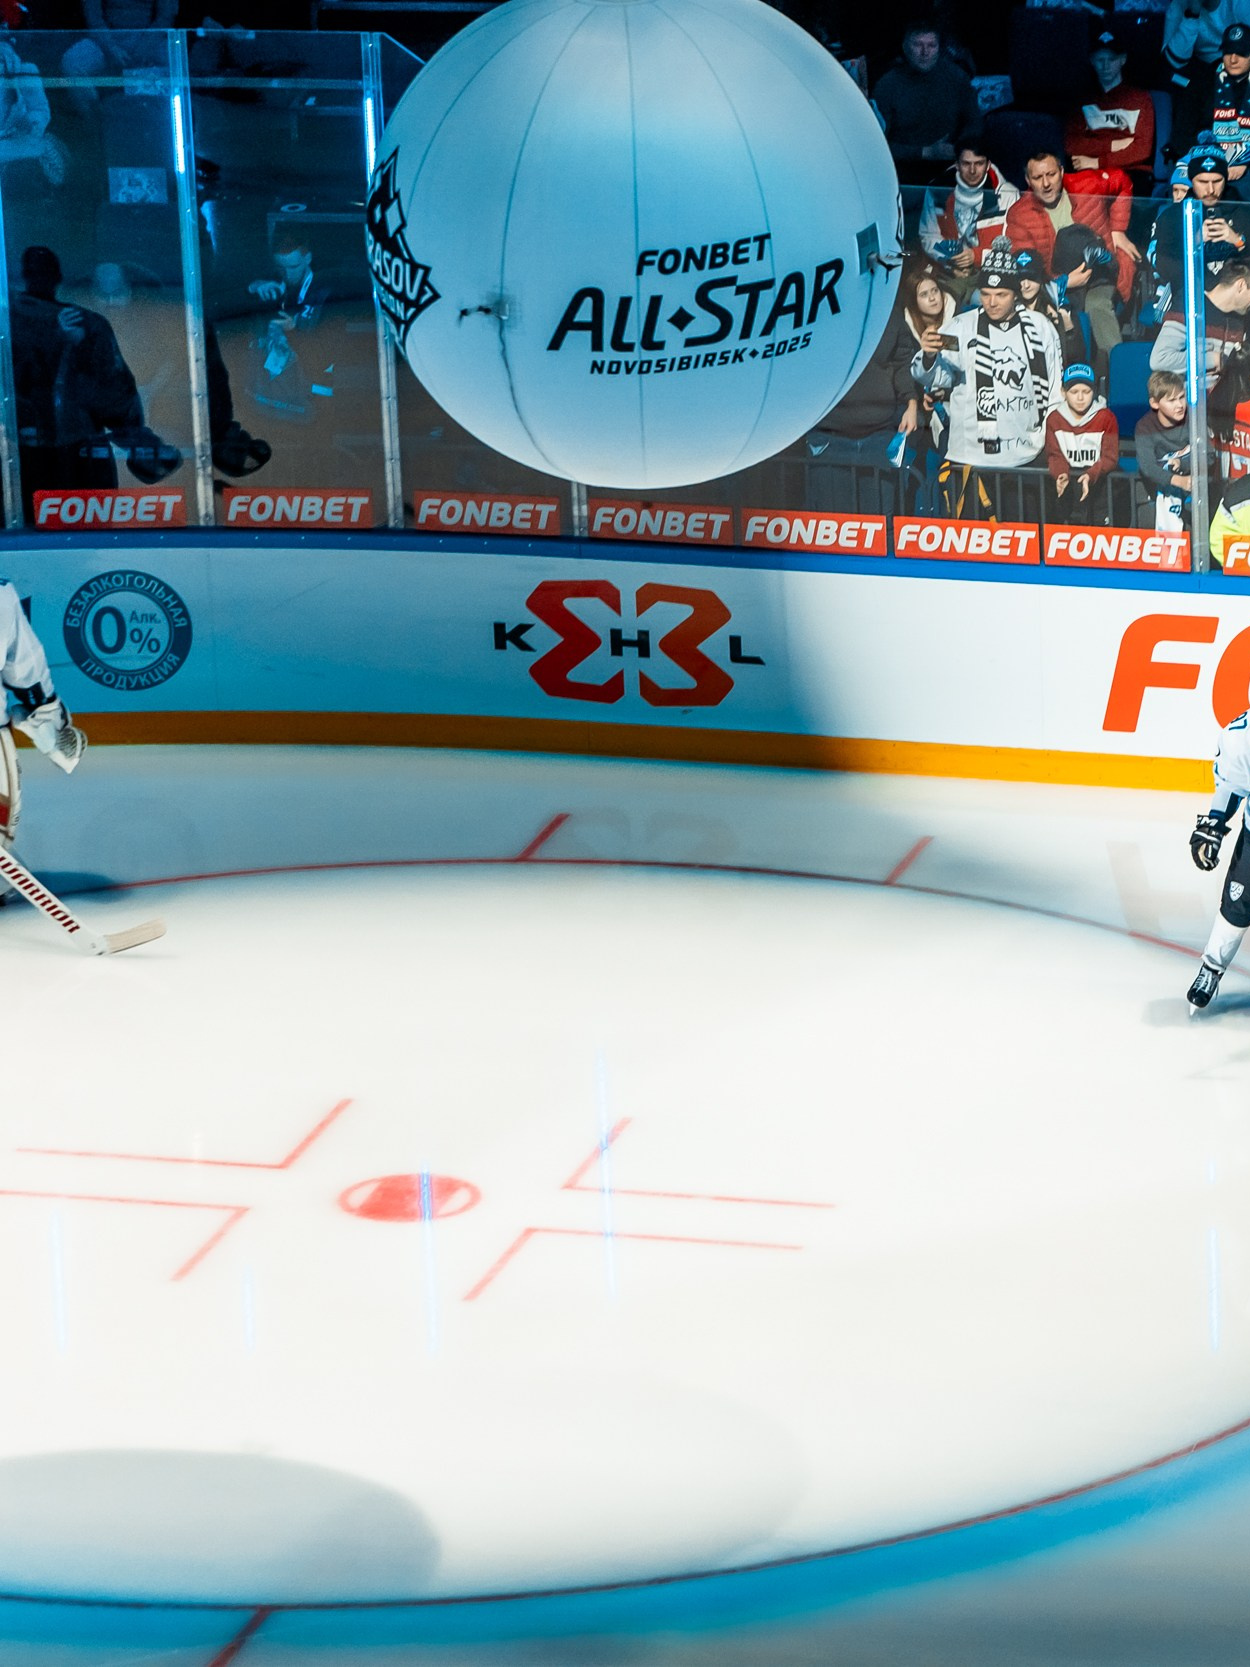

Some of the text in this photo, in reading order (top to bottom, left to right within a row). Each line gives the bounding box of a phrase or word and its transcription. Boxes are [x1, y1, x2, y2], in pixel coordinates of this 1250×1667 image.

[635, 232, 771, 277] FONBET
[590, 331, 813, 375] NOVOSIBIRSK 2025
[38, 495, 182, 523] FONBET
[227, 495, 370, 522] FONBET
[417, 498, 557, 529] FONBET
[592, 506, 731, 540] FONBET
[744, 516, 883, 548] FONBET
[897, 524, 1036, 557] FONBET
[1047, 532, 1187, 565] FONBET
[66, 573, 188, 628] БЕЗАЛКОГОЛЬНАЯ
[81, 652, 180, 690] ПРОДУКЦИЯ
